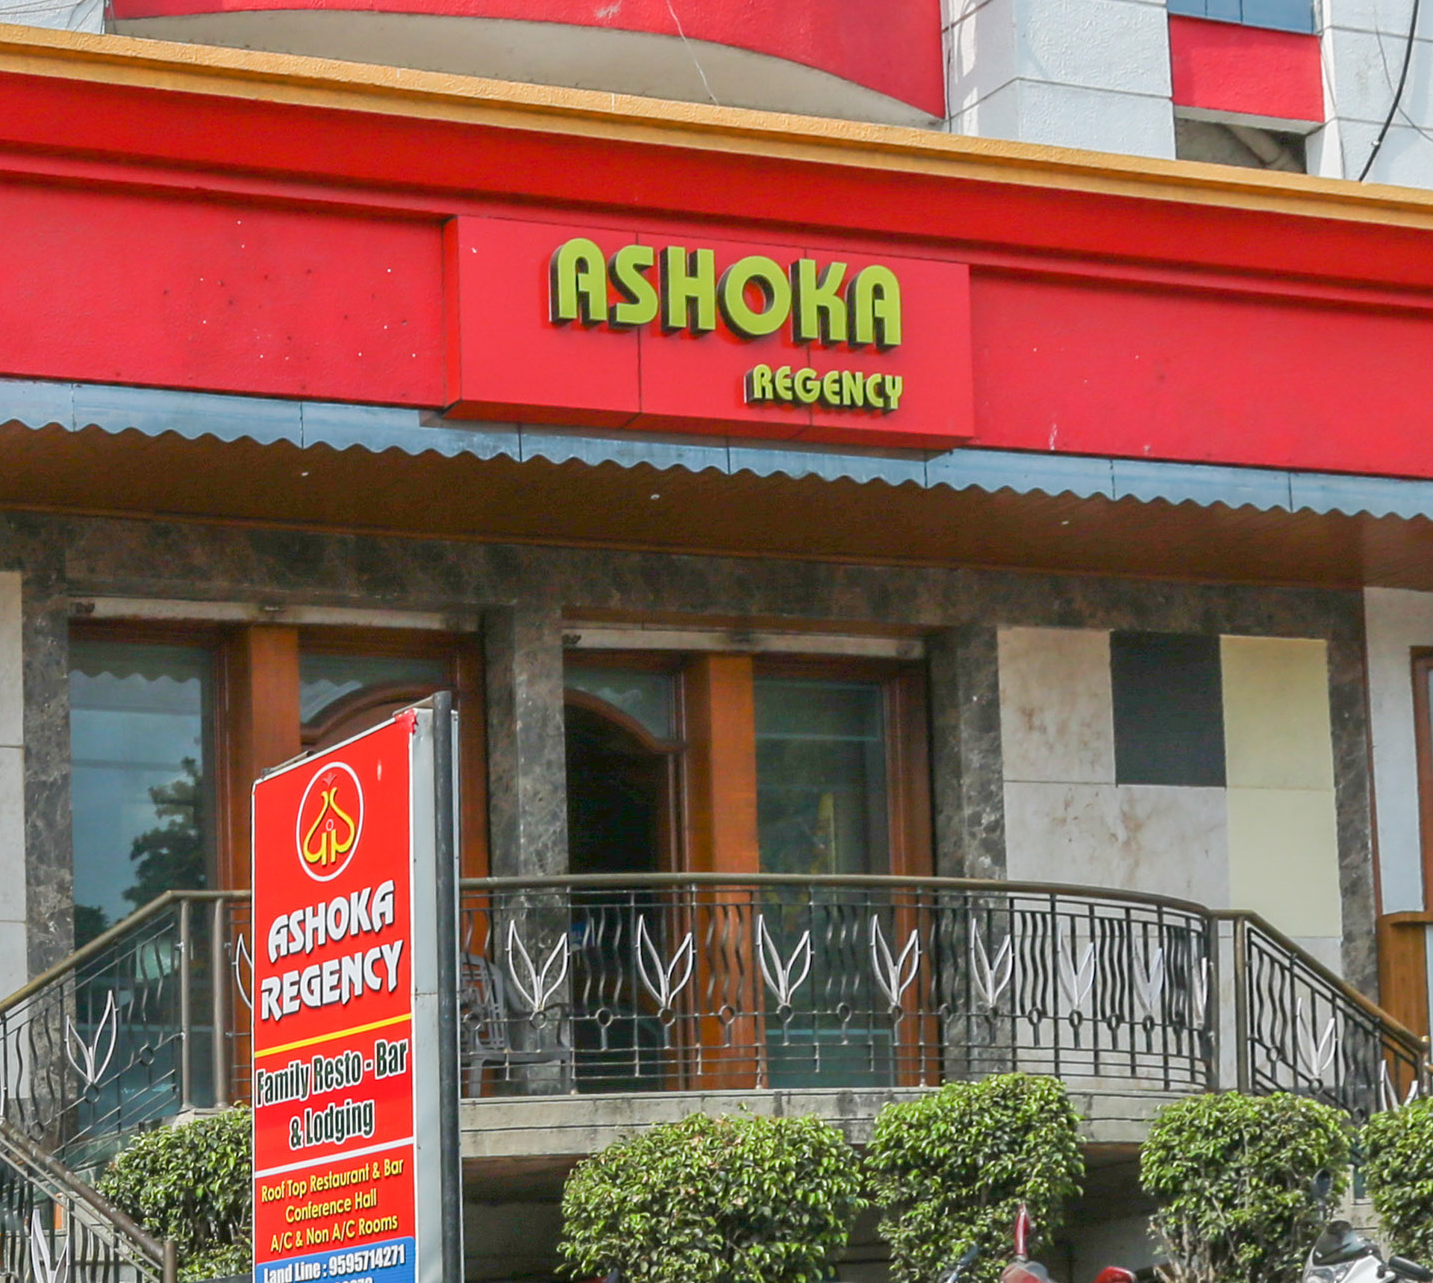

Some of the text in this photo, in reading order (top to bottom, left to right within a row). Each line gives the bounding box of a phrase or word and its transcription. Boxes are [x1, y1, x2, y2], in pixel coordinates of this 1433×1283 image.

[551, 237, 903, 347] ASHOKA
[746, 363, 903, 410] REGENCY
[268, 880, 395, 963] ASHOKA
[261, 939, 404, 1021] REGENCY
[256, 1060, 310, 1108] Family
[312, 1050, 363, 1095] Resto
[375, 1038, 409, 1079] Bar
[289, 1098, 375, 1150] & Lodging
[261, 1158, 403, 1202] Roof Top Restaurant & Bar
[286, 1188, 377, 1223] Conference Hall
[270, 1215, 398, 1253] A/C & Non A/C Rooms
[264, 1264, 293, 1283] Land
[294, 1261, 321, 1281] Line
[329, 1243, 405, 1277] 9595714271
